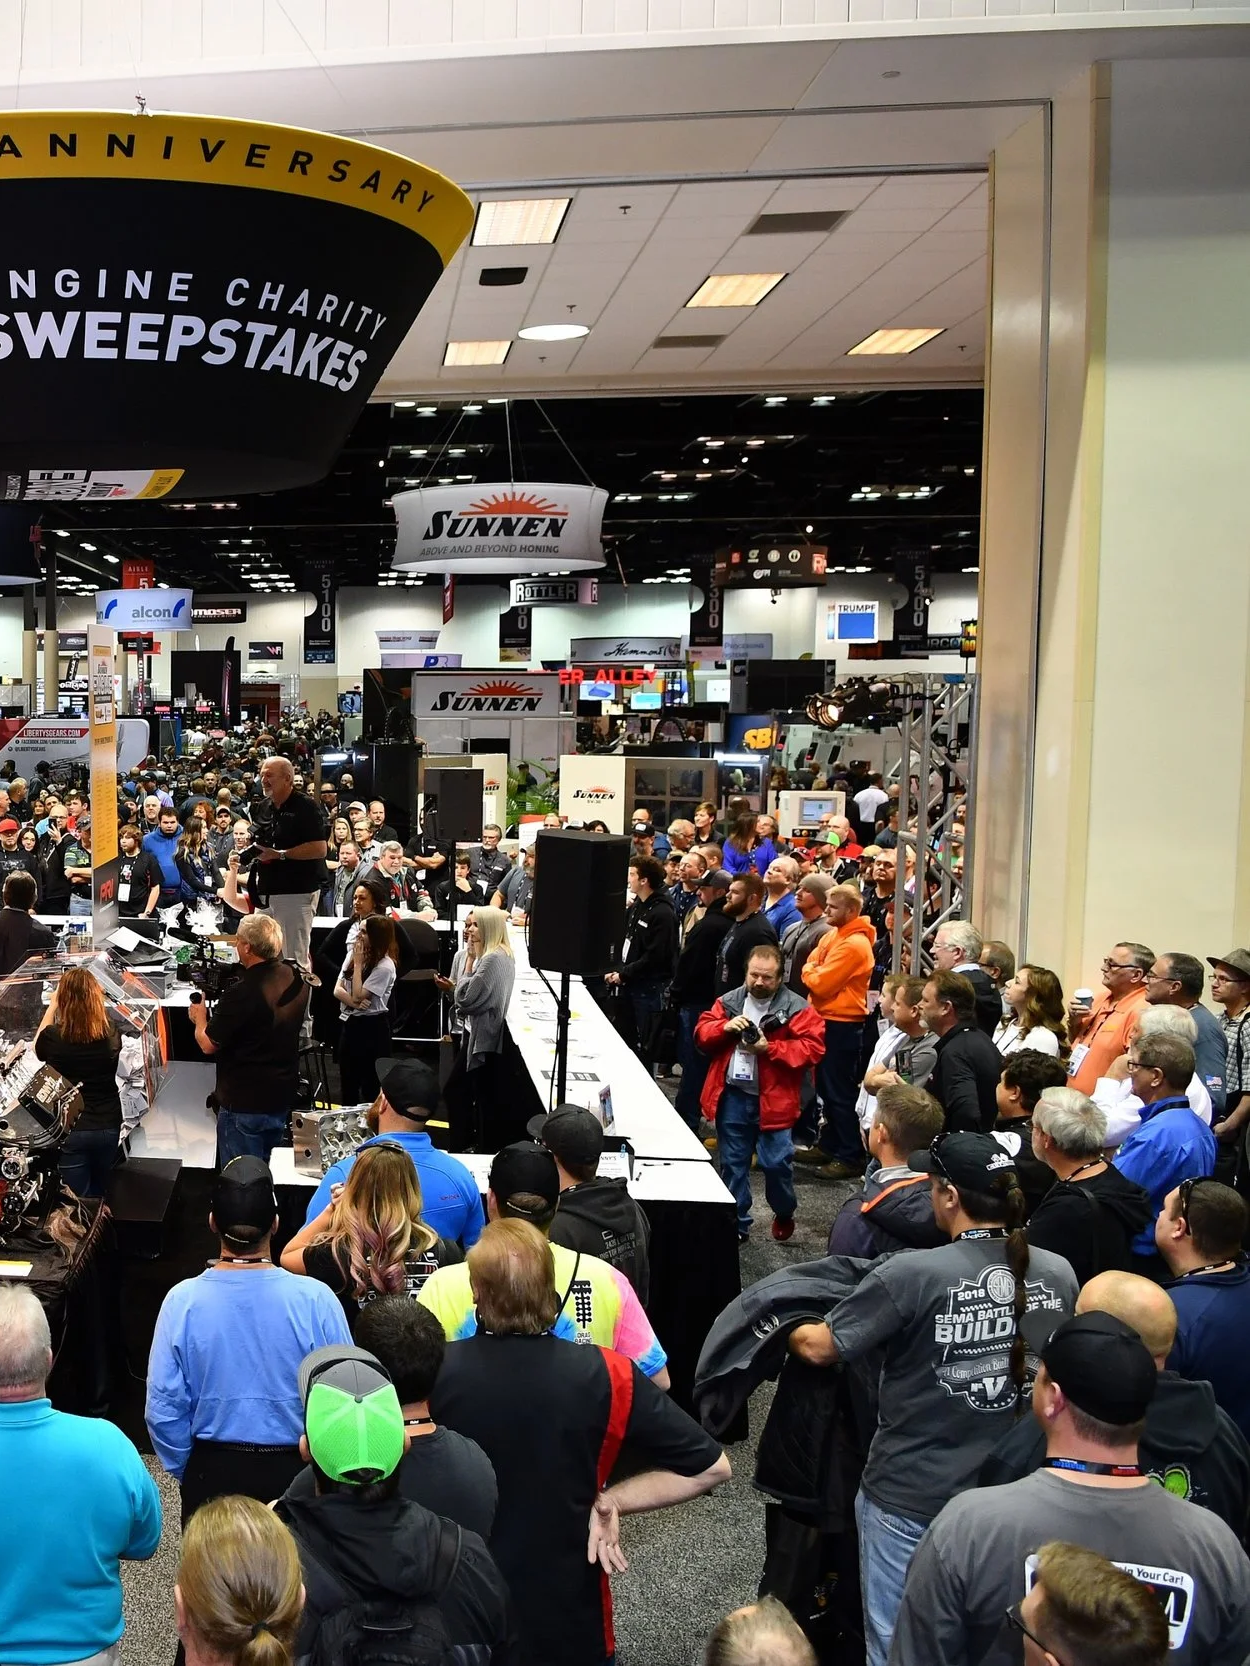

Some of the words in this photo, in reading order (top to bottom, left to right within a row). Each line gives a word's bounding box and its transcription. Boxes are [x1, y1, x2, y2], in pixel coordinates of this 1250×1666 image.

[226, 276, 387, 341] CHARITY
[422, 510, 568, 541] SUNNEN
[419, 545, 449, 557] ABOVE
[449, 545, 473, 554] AND
[474, 544, 518, 554] BEYOND
[519, 544, 559, 554] HONING
[321, 574, 331, 632] 5100
[131, 605, 172, 619] alcon
[594, 668, 659, 684] ALLEY
[430, 691, 543, 712] SUNNEN
[22, 729, 81, 737] LIBERTYSGEARS.COM
[572, 789, 616, 801] SUNNEN
[957, 1288, 986, 1301] 2018
[935, 1312, 975, 1324] SEMA
[1041, 1298, 1062, 1310] THE
[1136, 1567, 1162, 1581] Your
[1162, 1572, 1185, 1586] Car!
